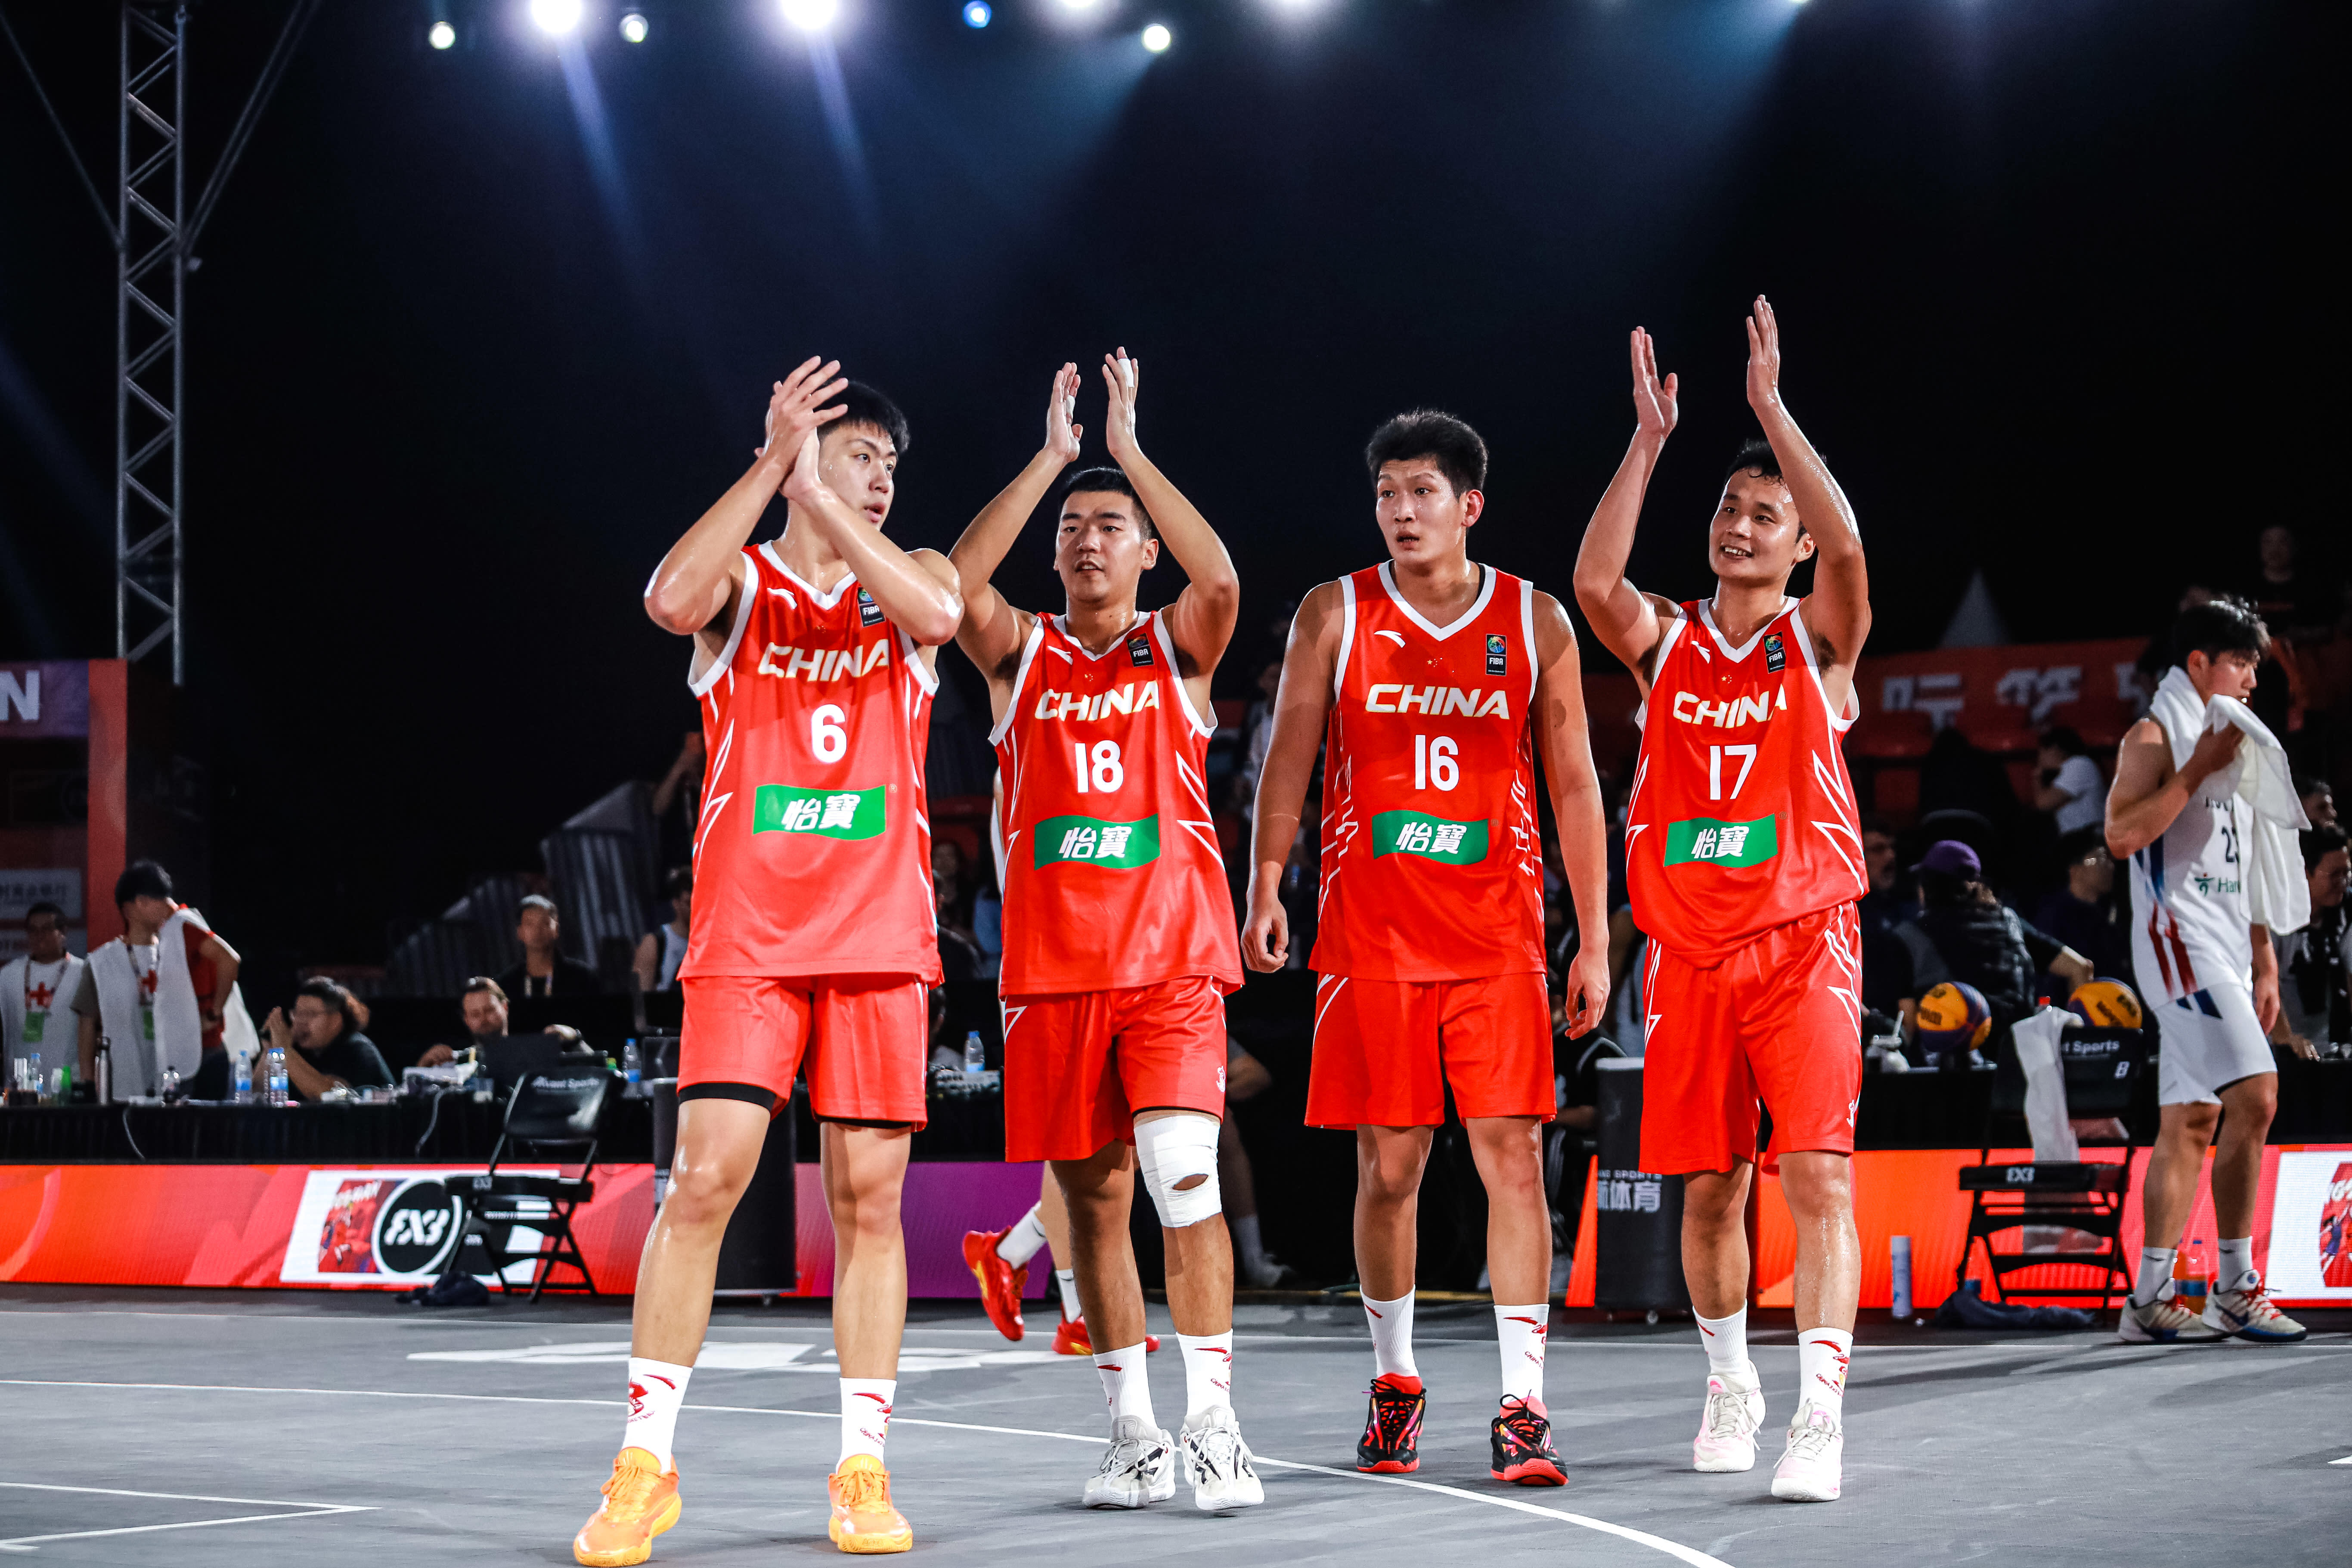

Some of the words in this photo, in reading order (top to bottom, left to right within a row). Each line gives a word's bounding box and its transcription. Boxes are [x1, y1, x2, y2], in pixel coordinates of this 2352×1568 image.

[863, 605, 880, 615] FIBA
[757, 639, 889, 682] CHINA
[1133, 648, 1149, 657] FIBA
[1489, 657, 1503, 665] FIBA
[1769, 652, 1783, 663] FIBA
[1035, 680, 1160, 722] CHINA
[1365, 683, 1510, 720] CHINA
[1673, 683, 1788, 728] CHINA
[811, 704, 847, 764] 6
[1075, 740, 1124, 793] 18
[1415, 734, 1460, 791] 16
[1710, 744, 1757, 800] 17
[781, 794, 861, 831] 怡寶
[1059, 826, 1132, 859] 怡寶
[1395, 822, 1467, 854] 怡寶
[1691, 826, 1750, 859] 怡寶
[2073, 1040, 2120, 1055] Sports
